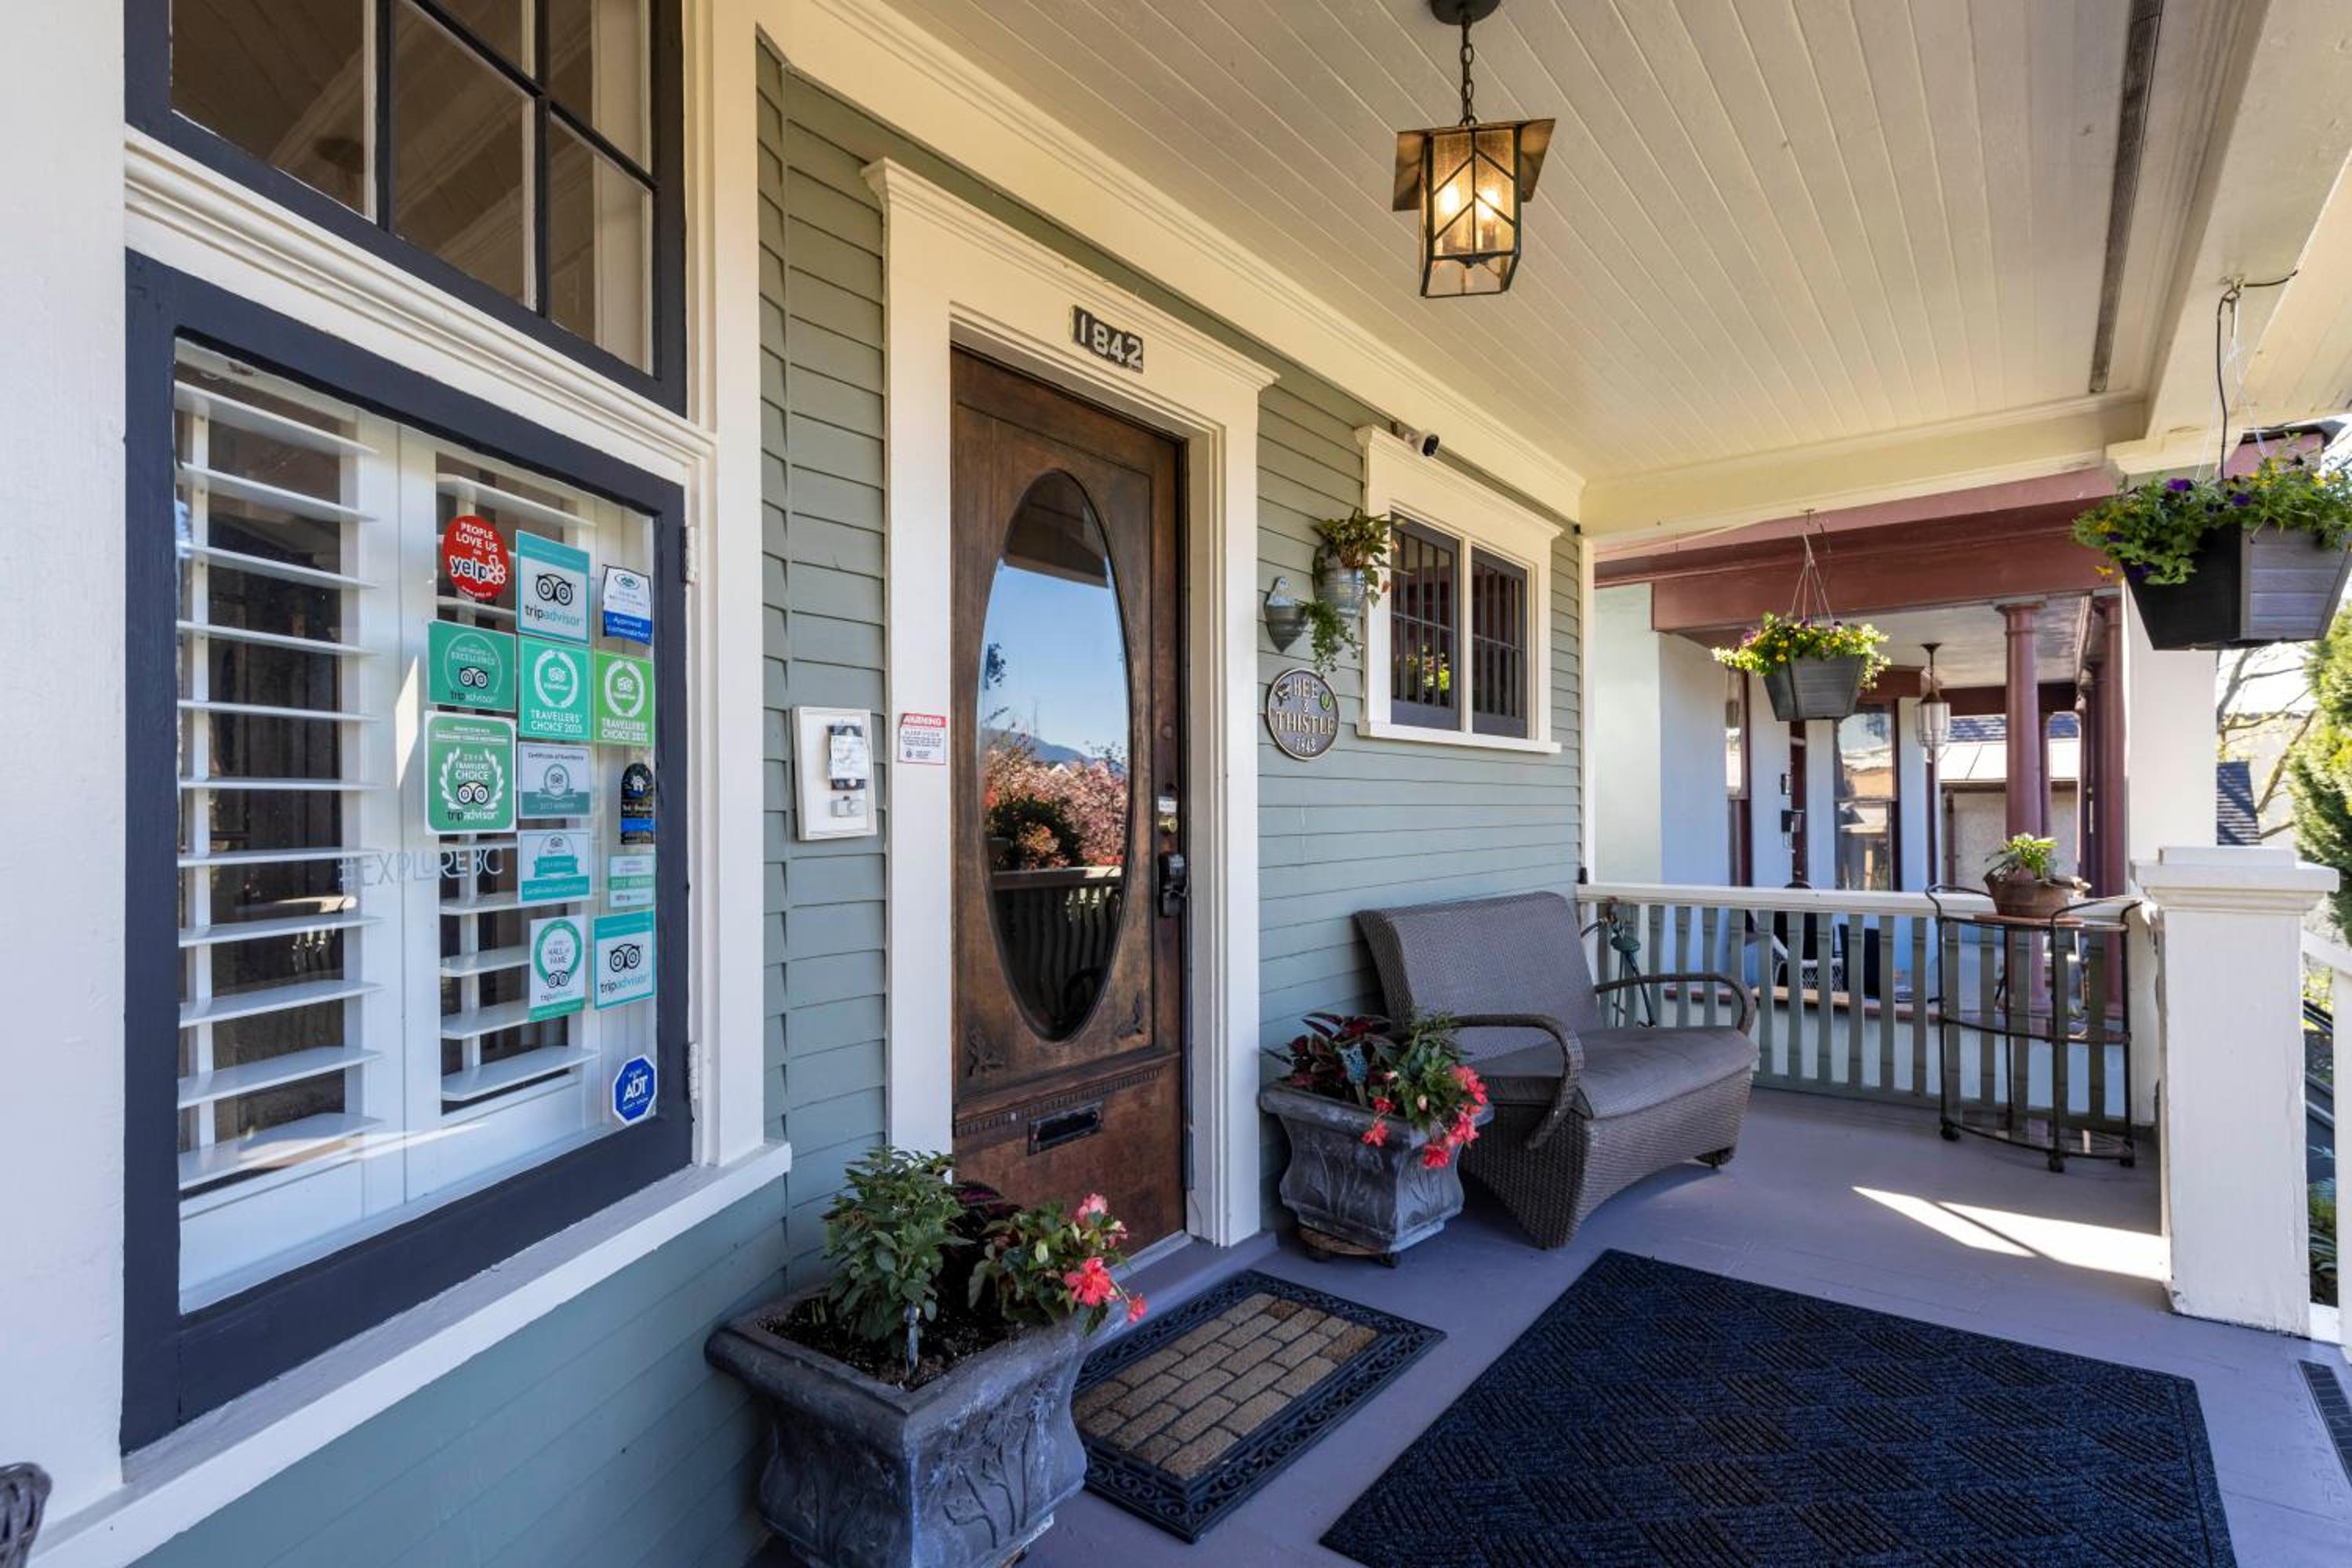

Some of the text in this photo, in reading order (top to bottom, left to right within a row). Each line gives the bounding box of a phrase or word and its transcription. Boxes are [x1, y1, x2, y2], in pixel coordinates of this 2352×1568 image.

[1080, 313, 1142, 369] 1842
[460, 522, 493, 540] PEOPLE
[456, 532, 498, 553] LOVE US
[451, 557, 488, 582] yelp
[524, 604, 582, 626] tripadvisor
[1294, 677, 1318, 699] BEE
[531, 721, 563, 732] CHOICE
[1276, 711, 1335, 735] THISTLE
[601, 729, 630, 741] CHOICE
[456, 770, 488, 780] CHOICE
[447, 809, 498, 823] tripadvisor
[623, 1075, 648, 1102] ADT
